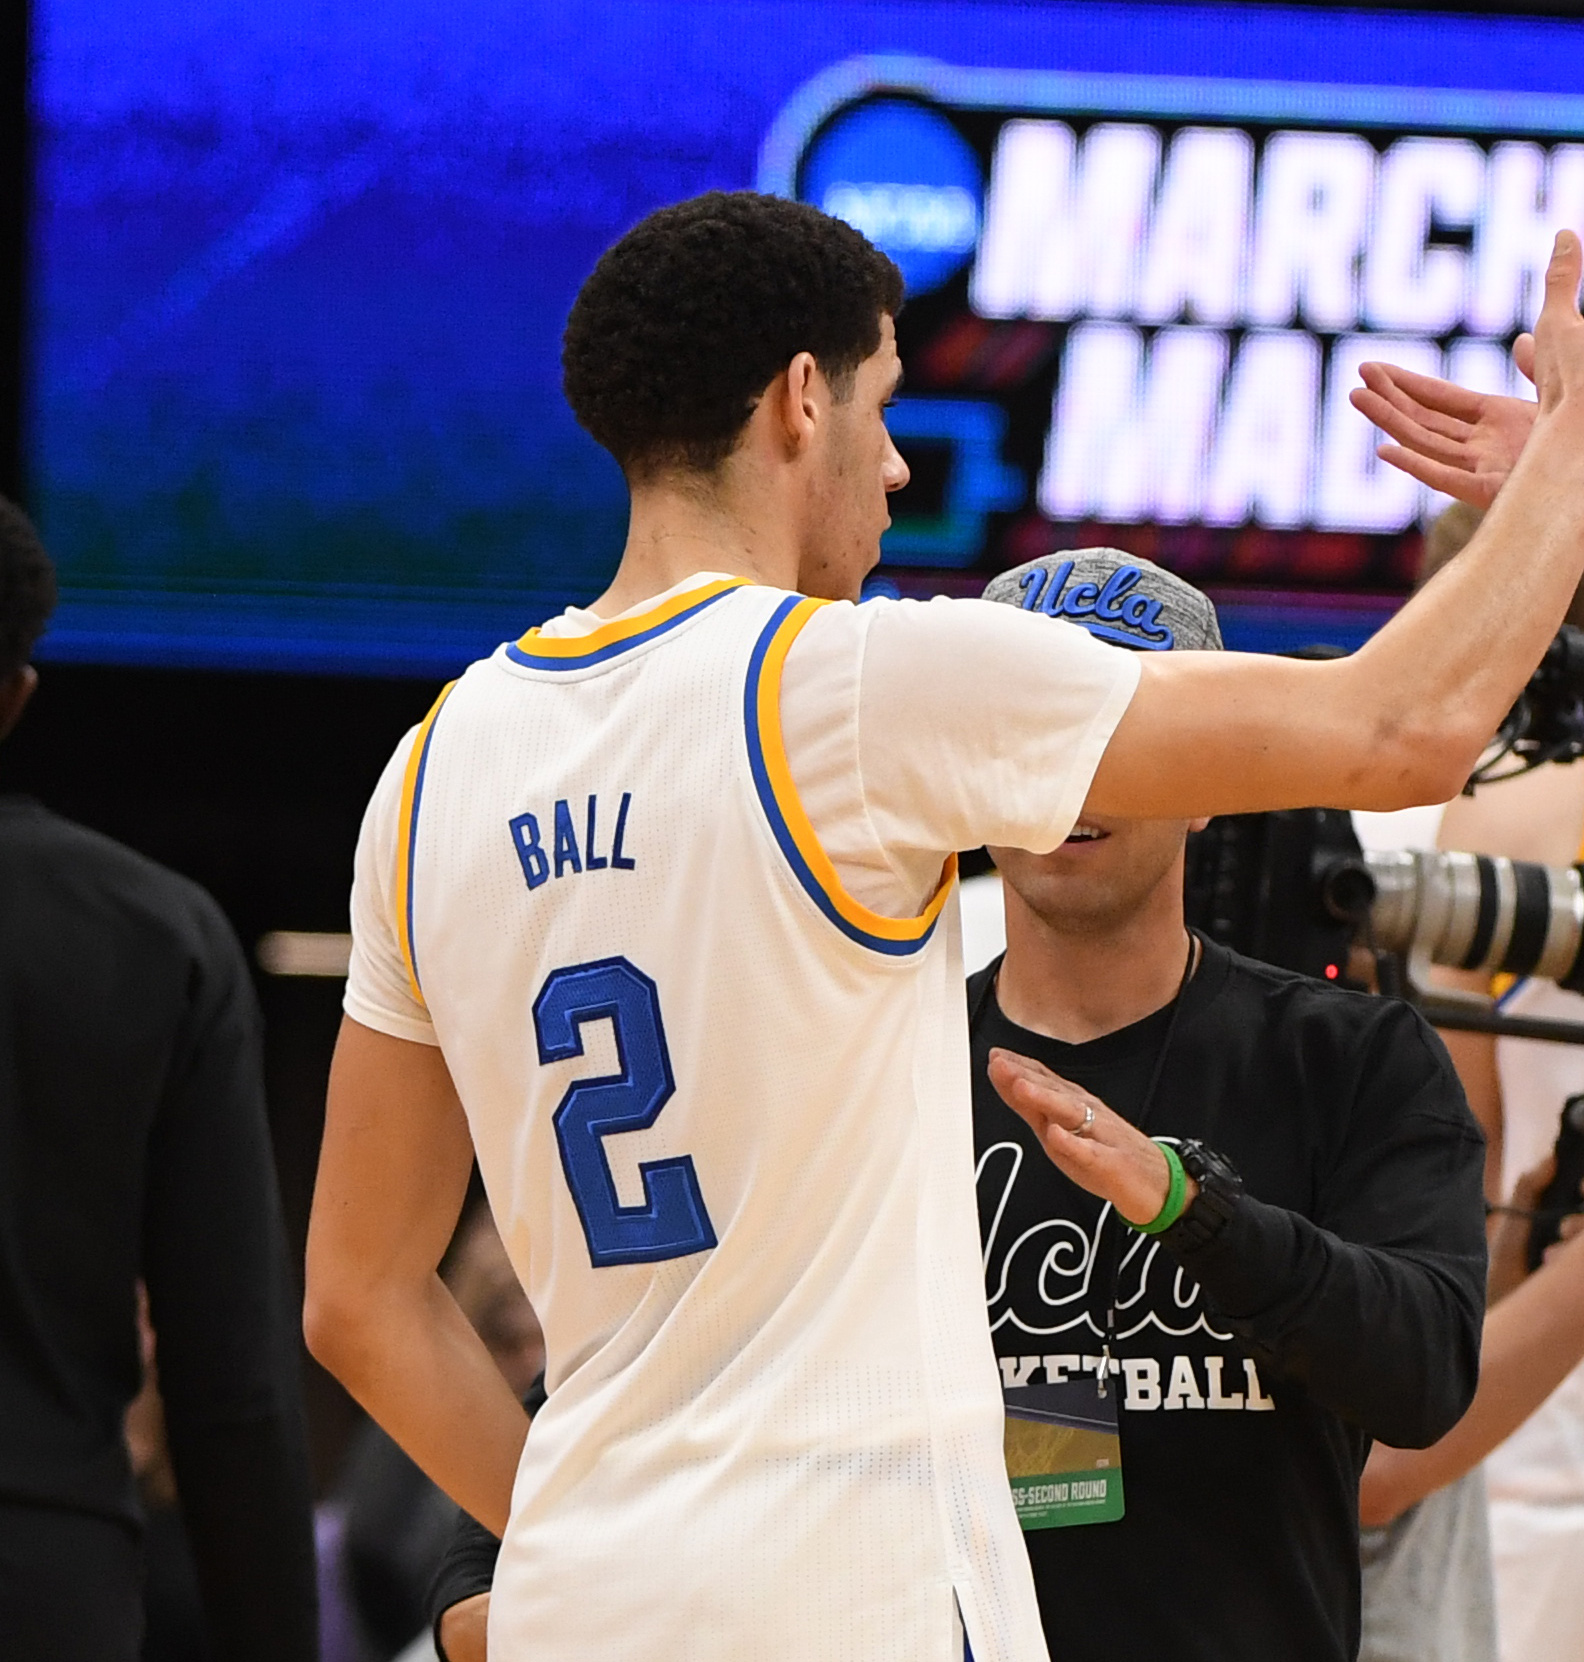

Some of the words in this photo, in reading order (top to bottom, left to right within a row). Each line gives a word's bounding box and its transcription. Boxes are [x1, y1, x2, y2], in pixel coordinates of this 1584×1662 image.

[1020, 560, 1174, 651] Ucla
[507, 792, 637, 891] BALL
[532, 955, 718, 1269] 2
[1070, 1479, 1108, 1500] ROUND
